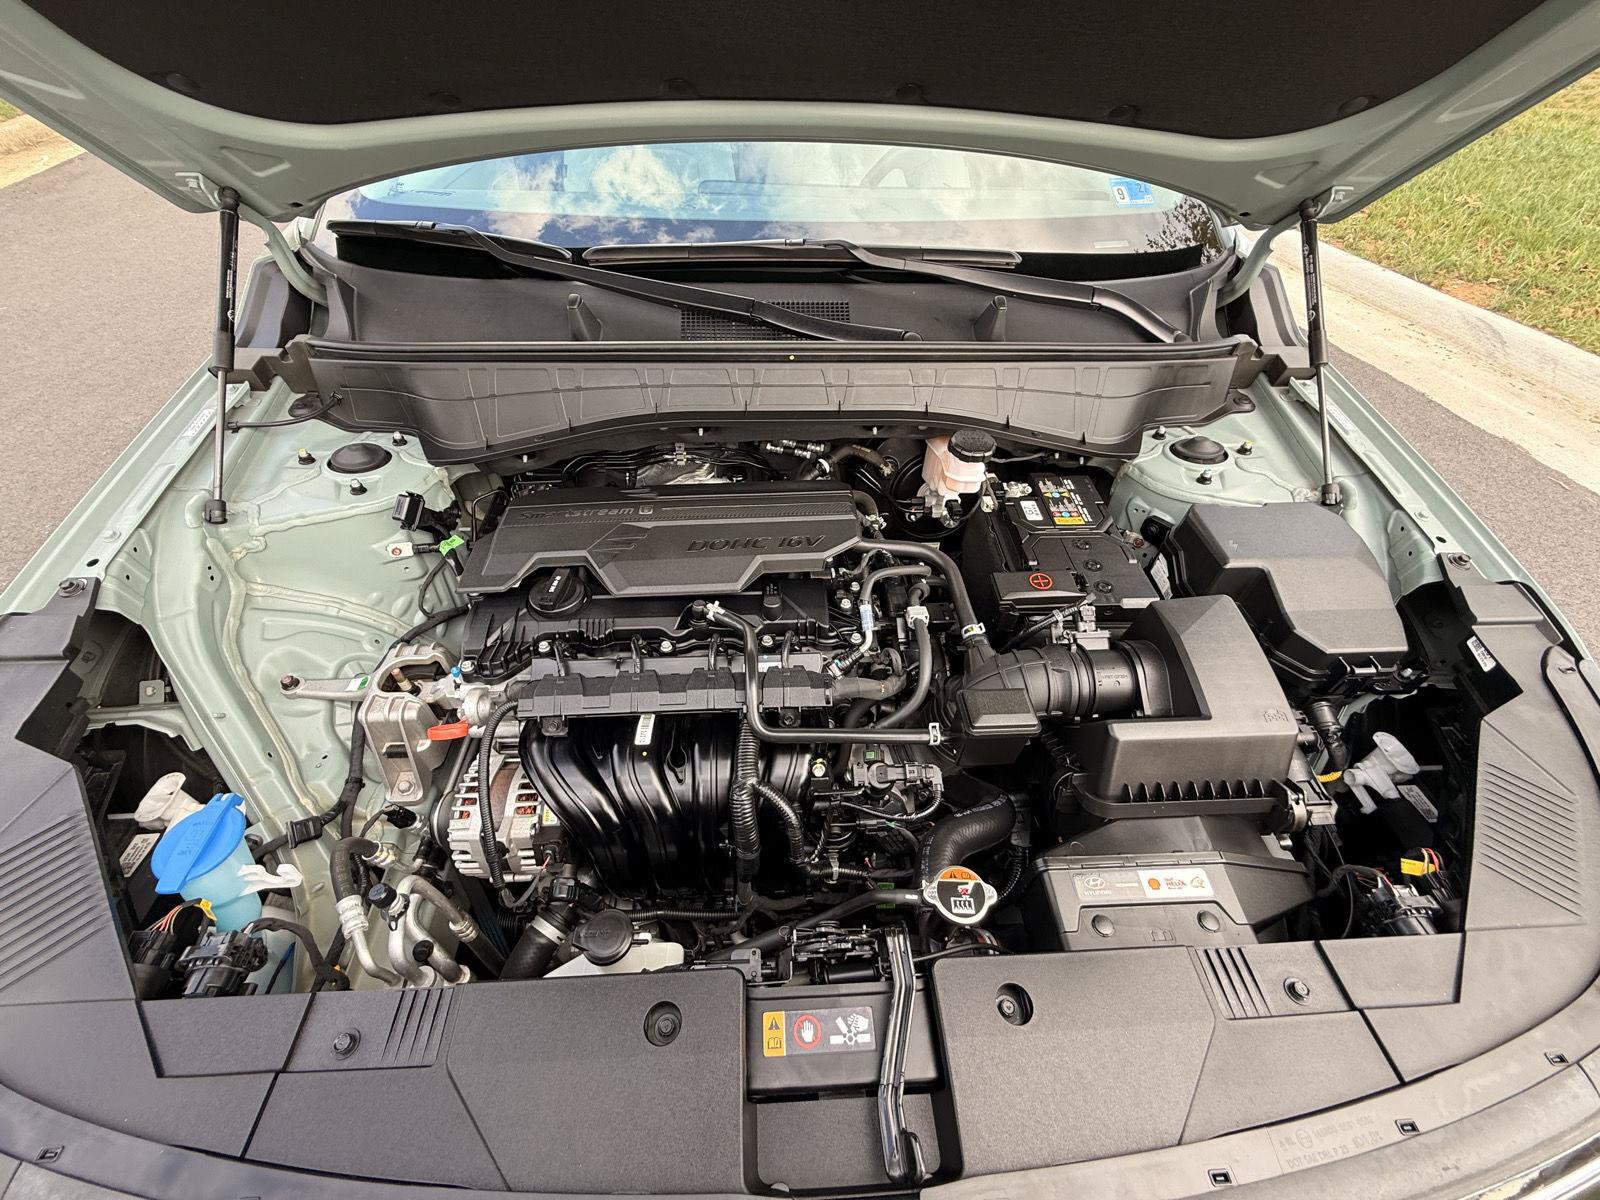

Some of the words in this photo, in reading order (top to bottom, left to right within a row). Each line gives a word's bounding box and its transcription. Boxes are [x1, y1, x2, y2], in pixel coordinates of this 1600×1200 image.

[1117, 187, 1125, 200] 9
[687, 537, 771, 552] DOHC
[778, 534, 826, 548] 16V
